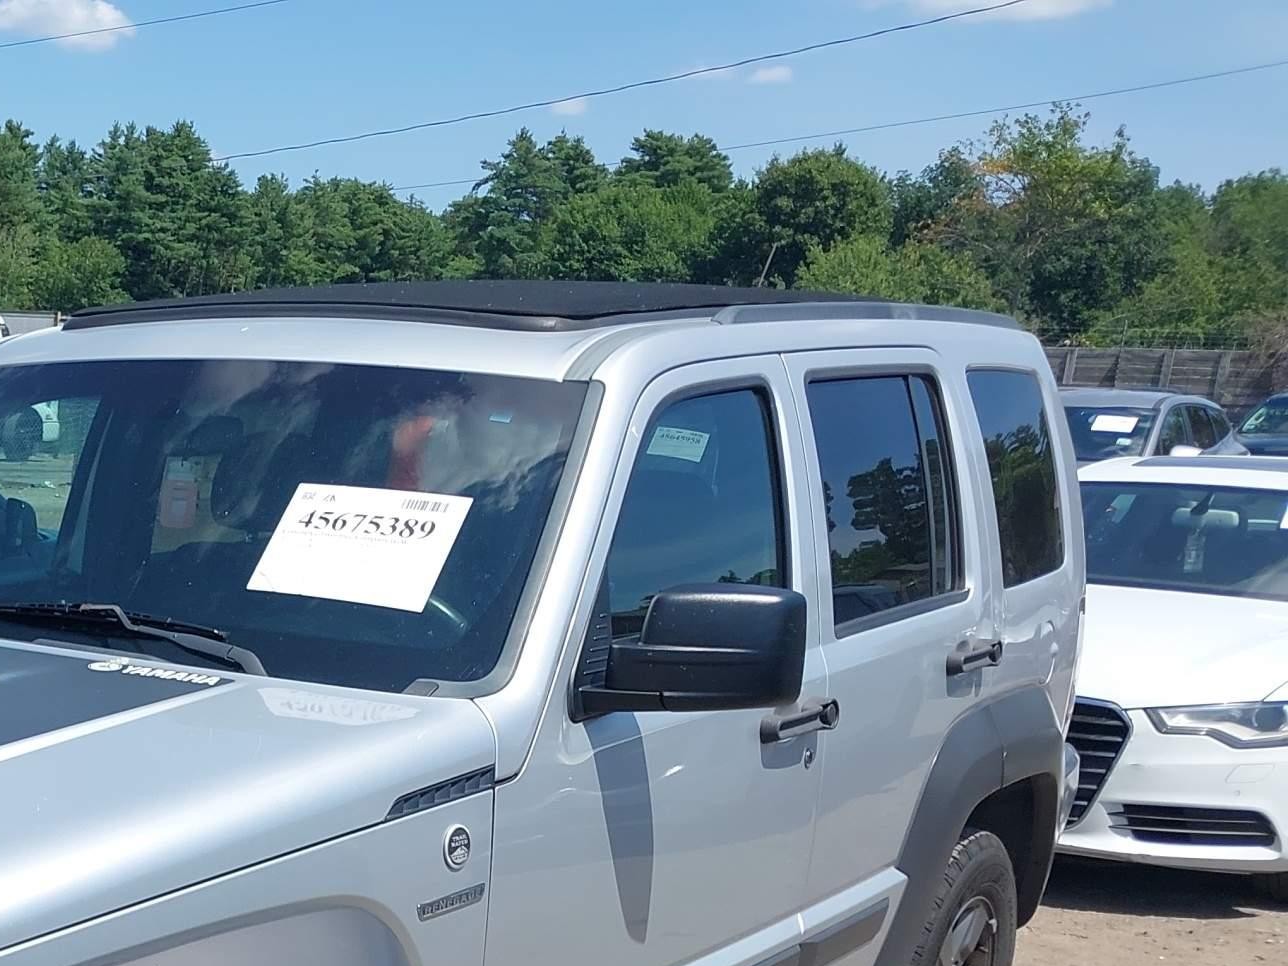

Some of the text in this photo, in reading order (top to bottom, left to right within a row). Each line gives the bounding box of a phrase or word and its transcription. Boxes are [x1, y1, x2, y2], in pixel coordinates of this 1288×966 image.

[298, 510, 436, 540] 45675389
[121, 664, 222, 686] YAMAHA
[422, 883, 484, 915] RENEGADE
